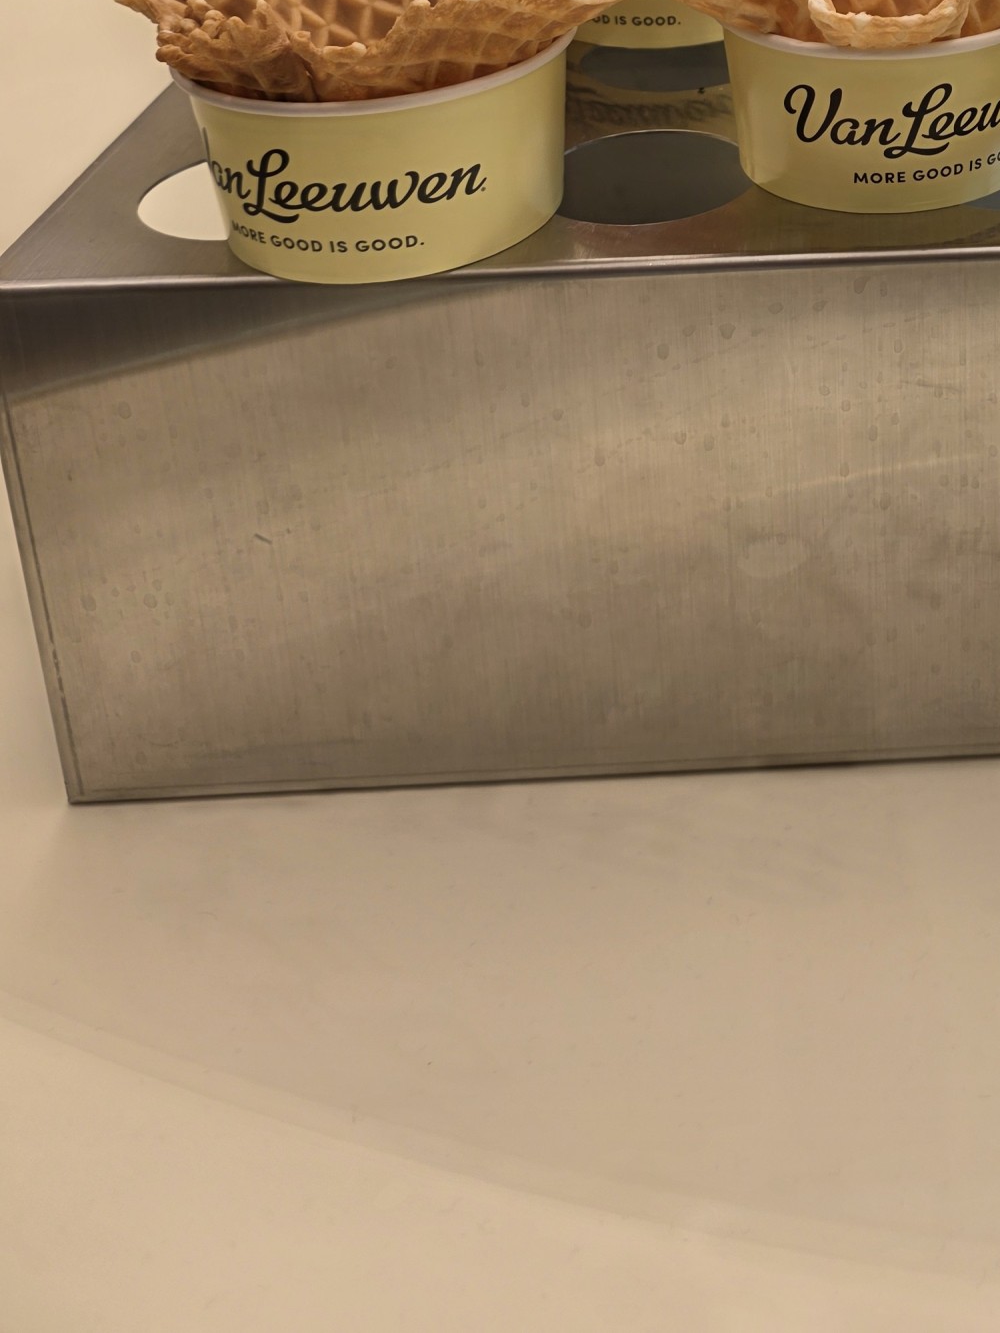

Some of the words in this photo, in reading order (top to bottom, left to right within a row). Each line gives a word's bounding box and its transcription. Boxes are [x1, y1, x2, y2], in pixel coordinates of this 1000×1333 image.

[615, 16, 627, 26] IS
[632, 15, 682, 26] GOOD.
[783, 83, 901, 146] Van
[853, 170, 907, 185] MORE
[912, 162, 964, 182] GOOD
[968, 156, 982, 172] IS
[231, 220, 267, 245] MORE
[270, 233, 324, 253] GOOD
[330, 240, 348, 254] IS
[355, 234, 425, 254] GOOD.
